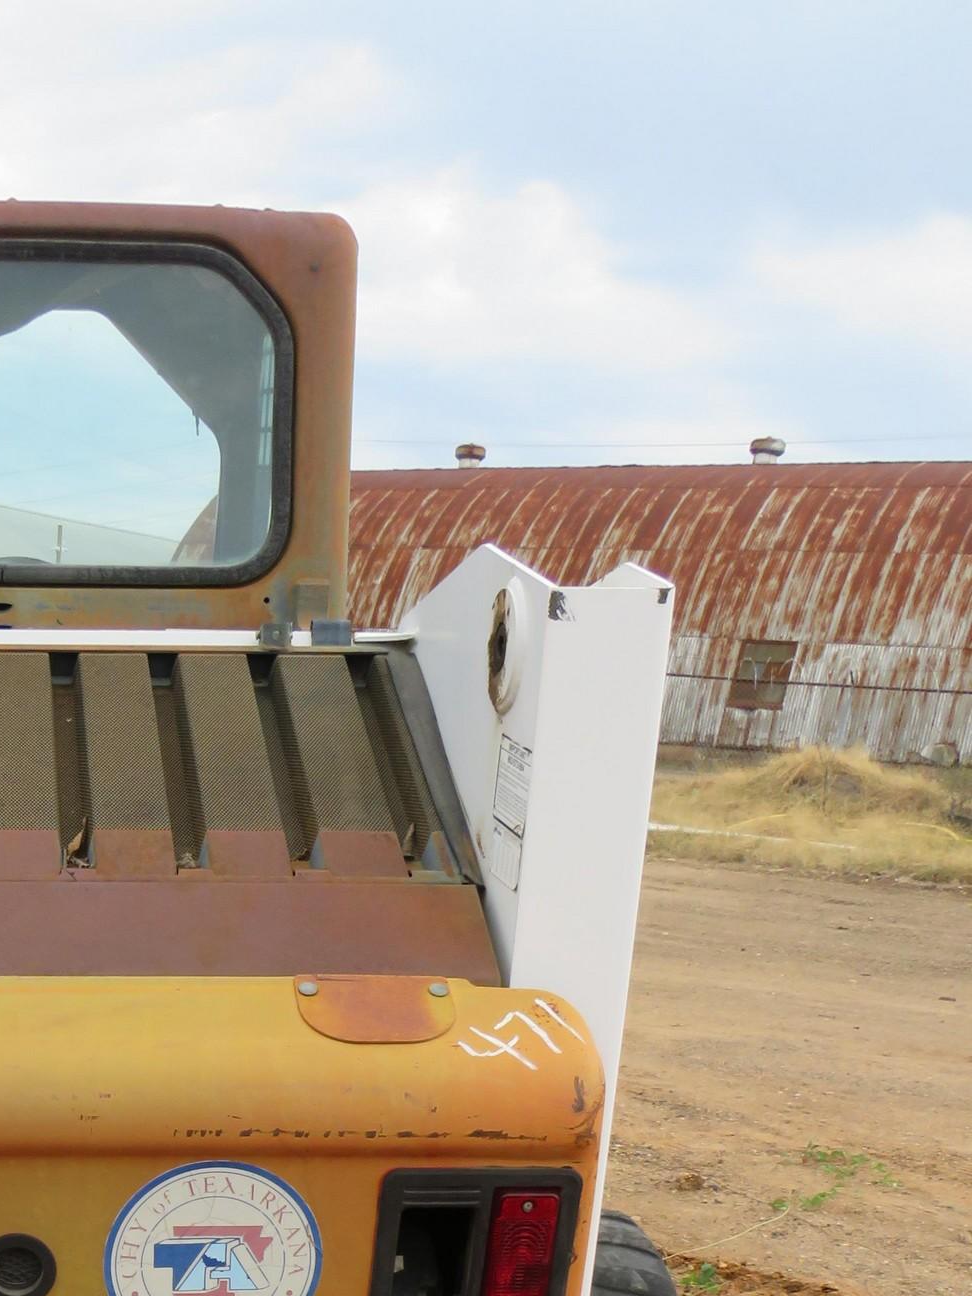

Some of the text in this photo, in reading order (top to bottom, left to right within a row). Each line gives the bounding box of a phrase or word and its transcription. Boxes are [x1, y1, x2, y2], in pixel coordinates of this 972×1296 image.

[119, 1175, 308, 1280] CITY of TEXARKANA
